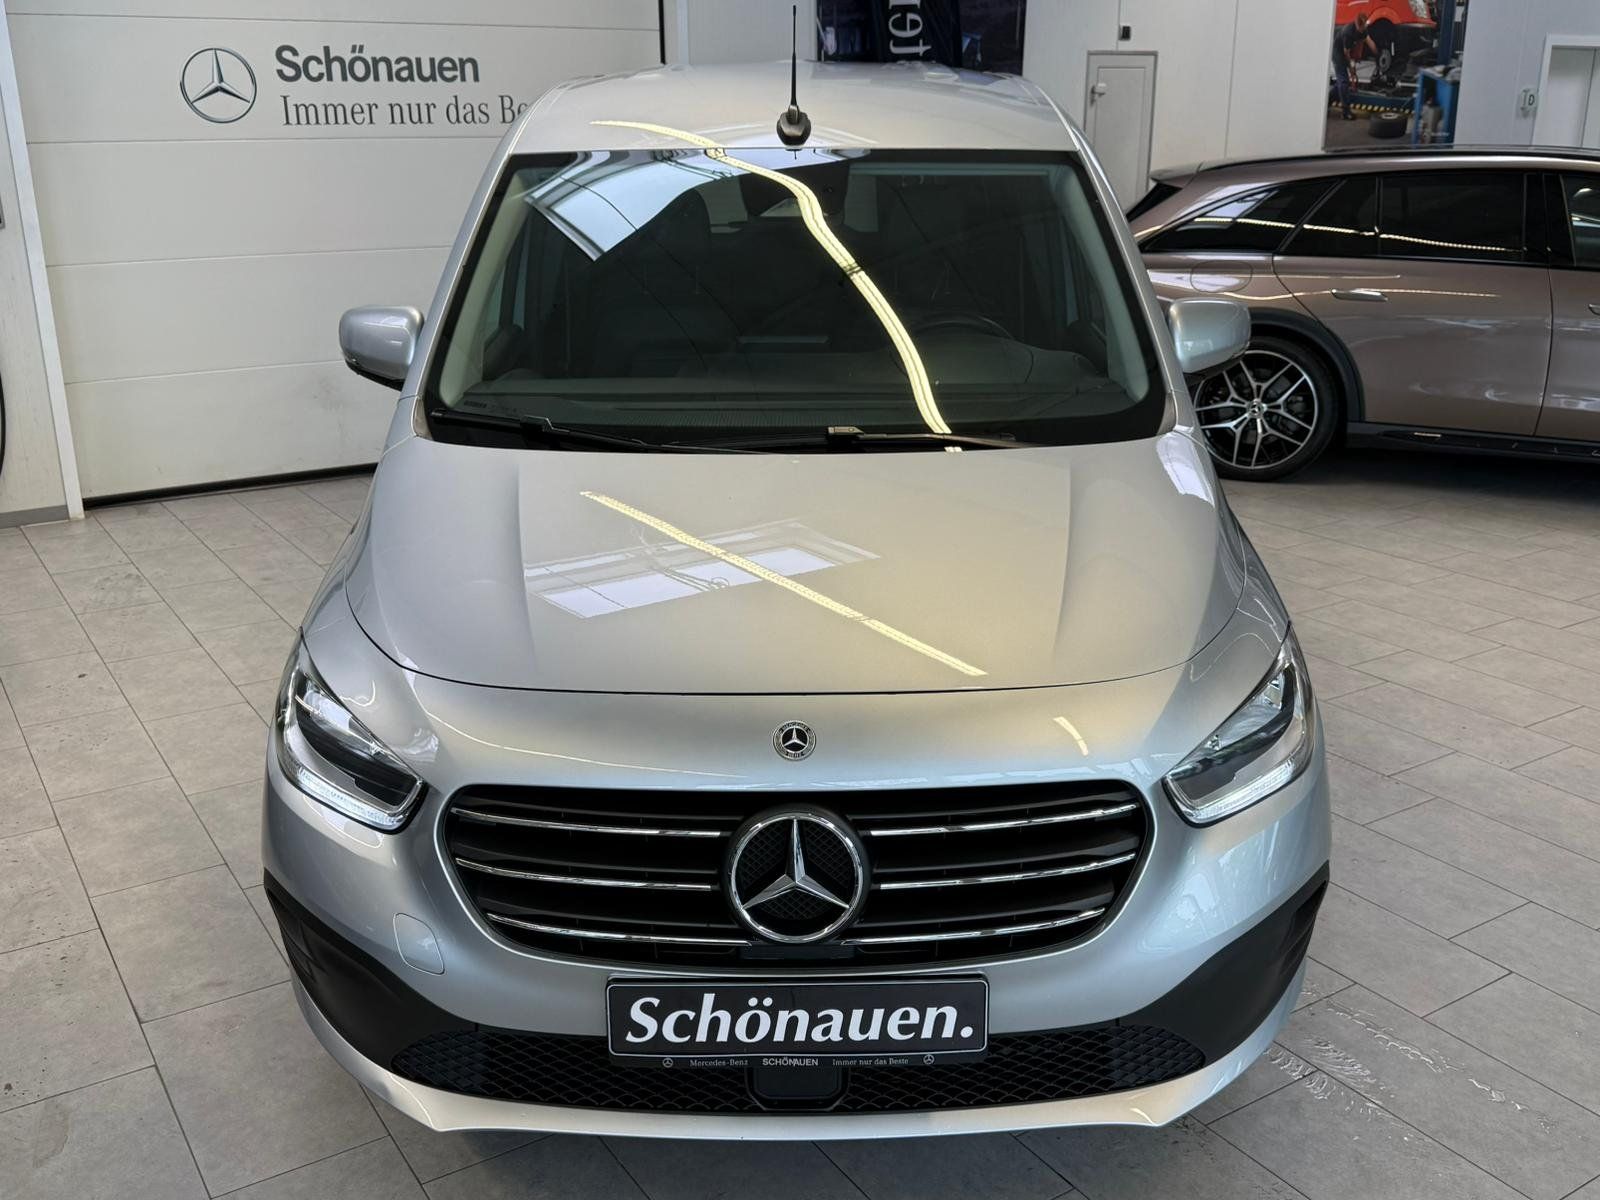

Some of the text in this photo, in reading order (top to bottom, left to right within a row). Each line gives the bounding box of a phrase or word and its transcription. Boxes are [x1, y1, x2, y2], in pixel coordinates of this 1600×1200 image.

[275, 44, 480, 83] Schönauen
[280, 94, 378, 126] Immer
[388, 101, 437, 125] nur
[446, 95, 490, 124] das
[625, 993, 974, 1043] Schönauen.
[689, 1059, 749, 1067] Mercedes-Benz
[762, 1057, 819, 1067] SCHÖNAUEN
[832, 1057, 909, 1066] Immer nur das Beste
